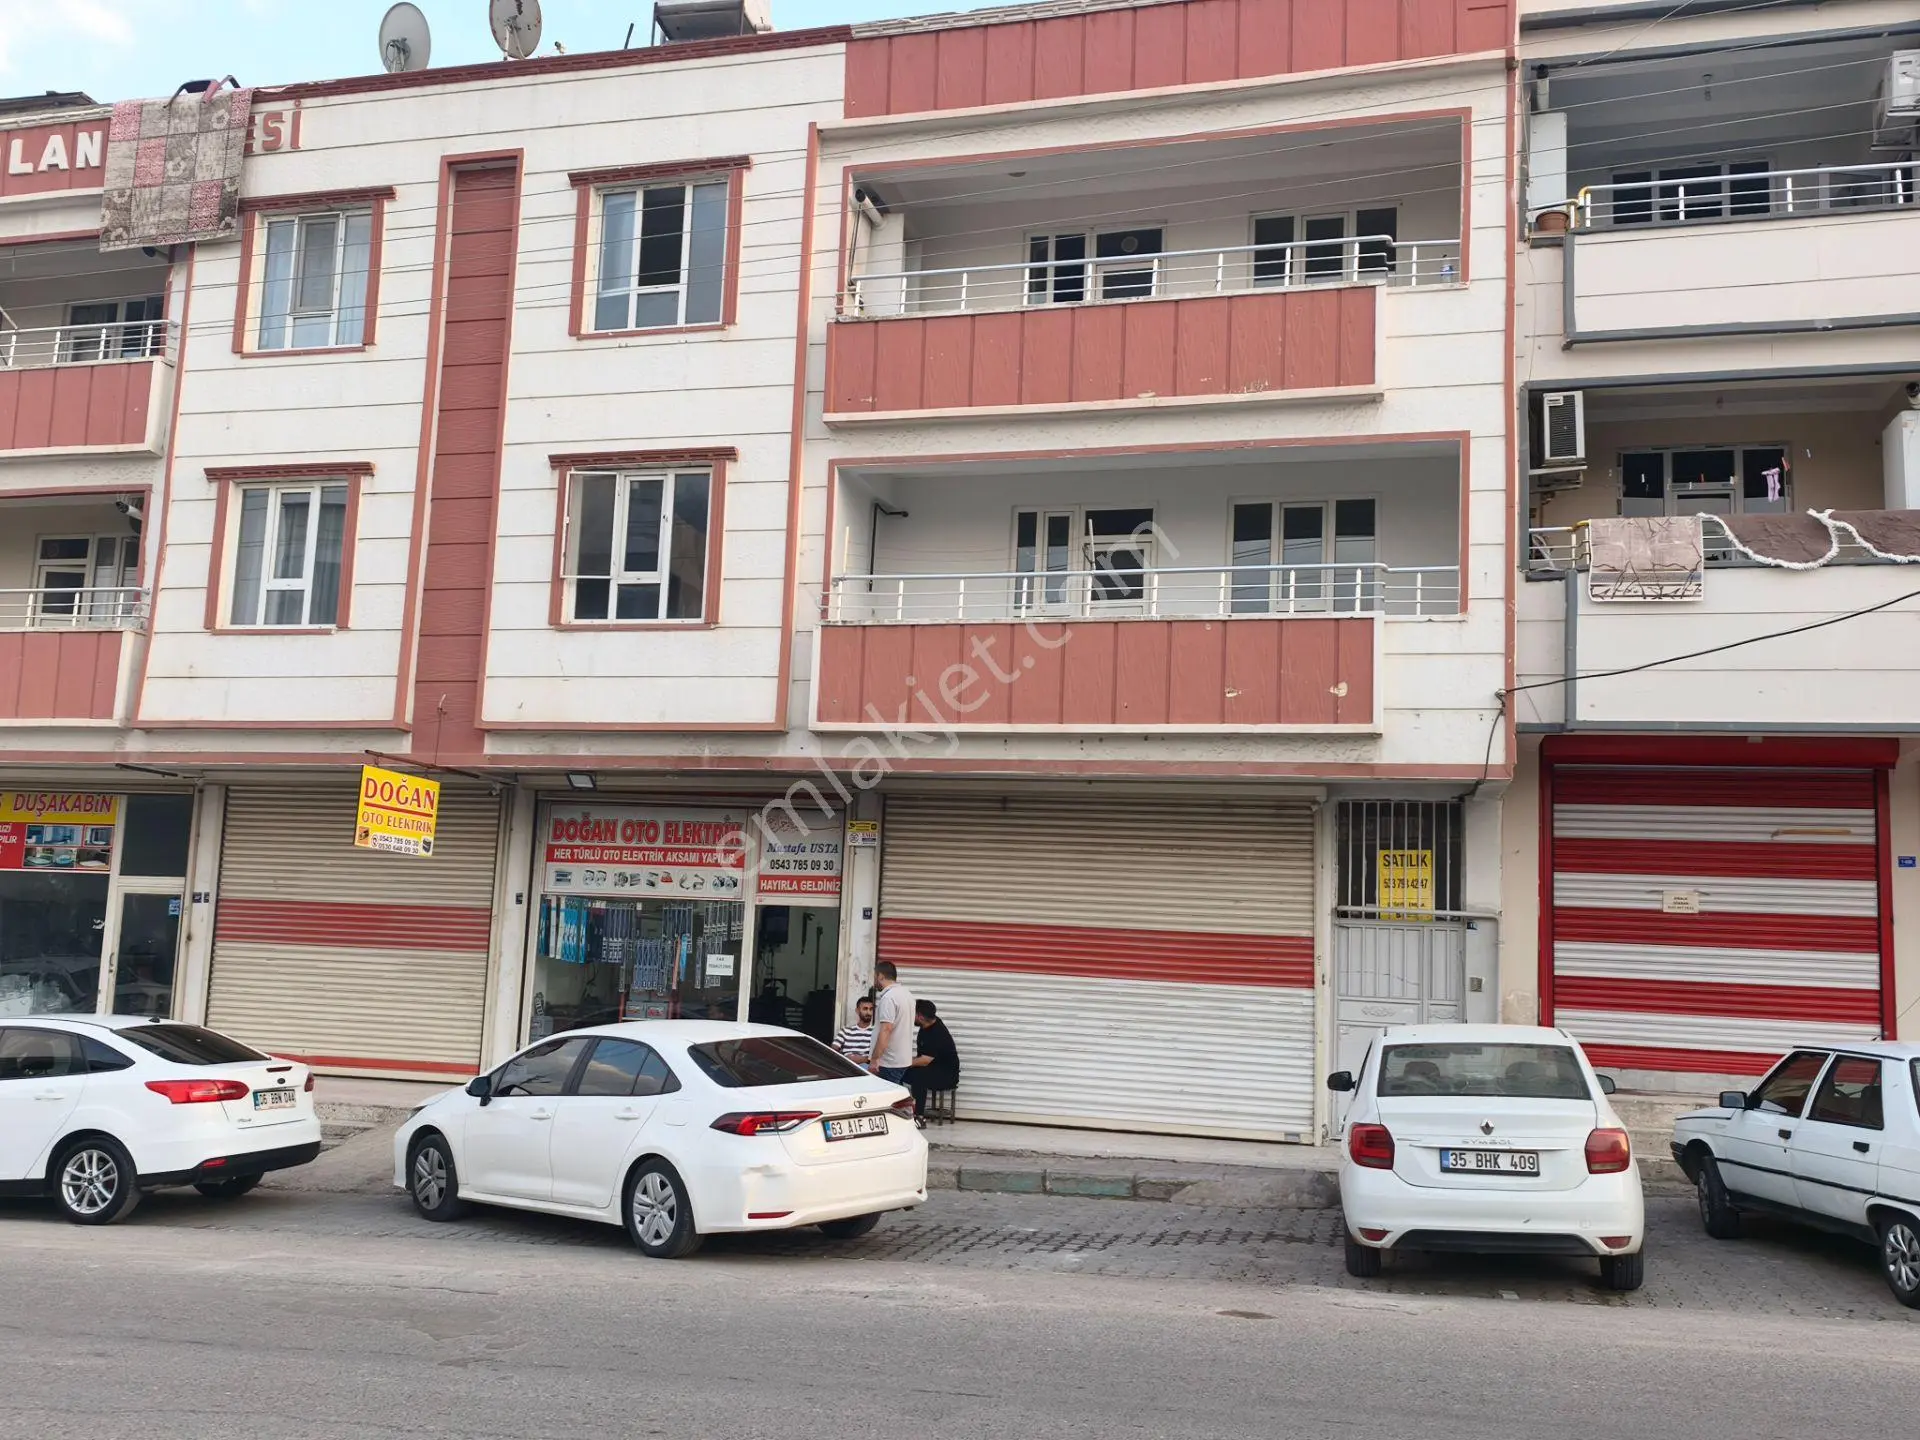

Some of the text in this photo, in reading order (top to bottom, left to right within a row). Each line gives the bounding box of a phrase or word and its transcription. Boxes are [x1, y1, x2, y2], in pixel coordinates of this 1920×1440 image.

[0, 131, 103, 175] LAN
[364, 777, 436, 810] DOĞAN
[13, 793, 114, 816] DUŞAKABİN
[361, 811, 384, 825] OTO
[552, 812, 619, 843] DOĞAN
[621, 819, 660, 844] OTO
[664, 814, 745, 846] ELEKTRİK
[554, 848, 571, 860] HER
[573, 847, 601, 860] TÜRLÜ
[603, 851, 620, 861] OTO
[623, 848, 664, 862] ELEKTRİK
[665, 852, 699, 863] AKSAMI
[767, 843, 839, 856] Mustafa USTA
[770, 859, 834, 870] 0543 785 09 30
[1383, 854, 1428, 868] SATILIK
[760, 879, 840, 892] HAYIRLA GELDİNİZ
[831, 1116, 886, 1136] 63 AIF 040
[1450, 1152, 1536, 1171] 35 BHK 409
